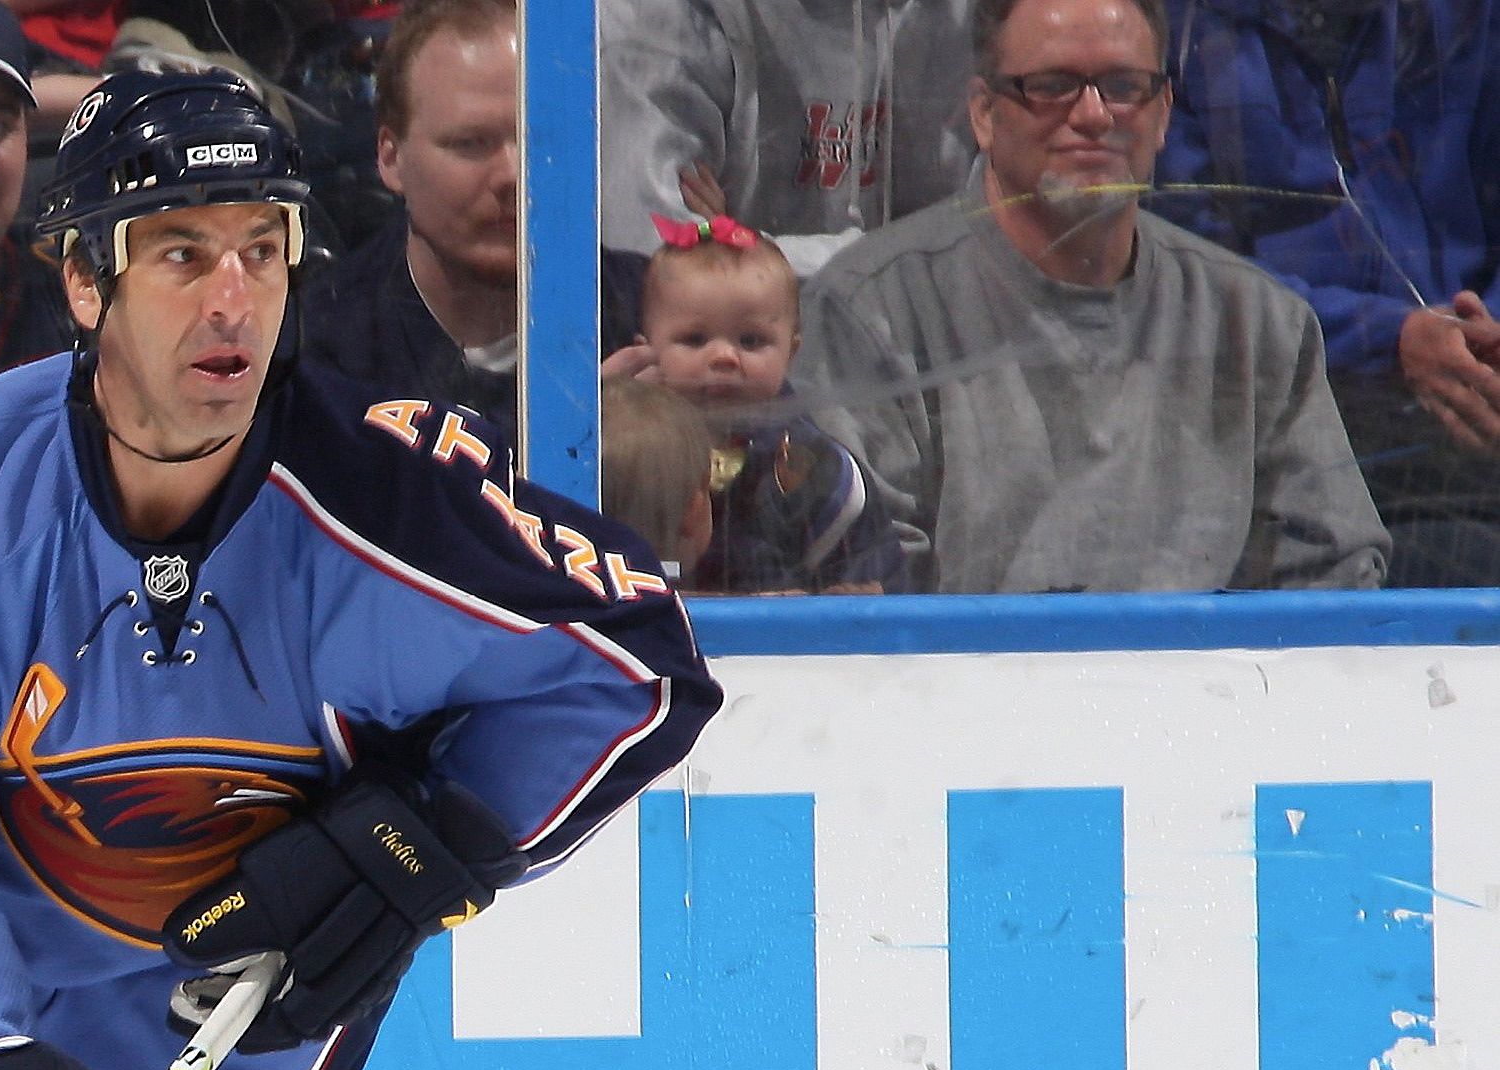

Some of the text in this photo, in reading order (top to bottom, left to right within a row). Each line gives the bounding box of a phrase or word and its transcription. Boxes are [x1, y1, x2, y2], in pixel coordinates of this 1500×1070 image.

[190, 146, 257, 164] CCM
[372, 822, 425, 876] Chelios
[181, 890, 247, 944] Reebok
